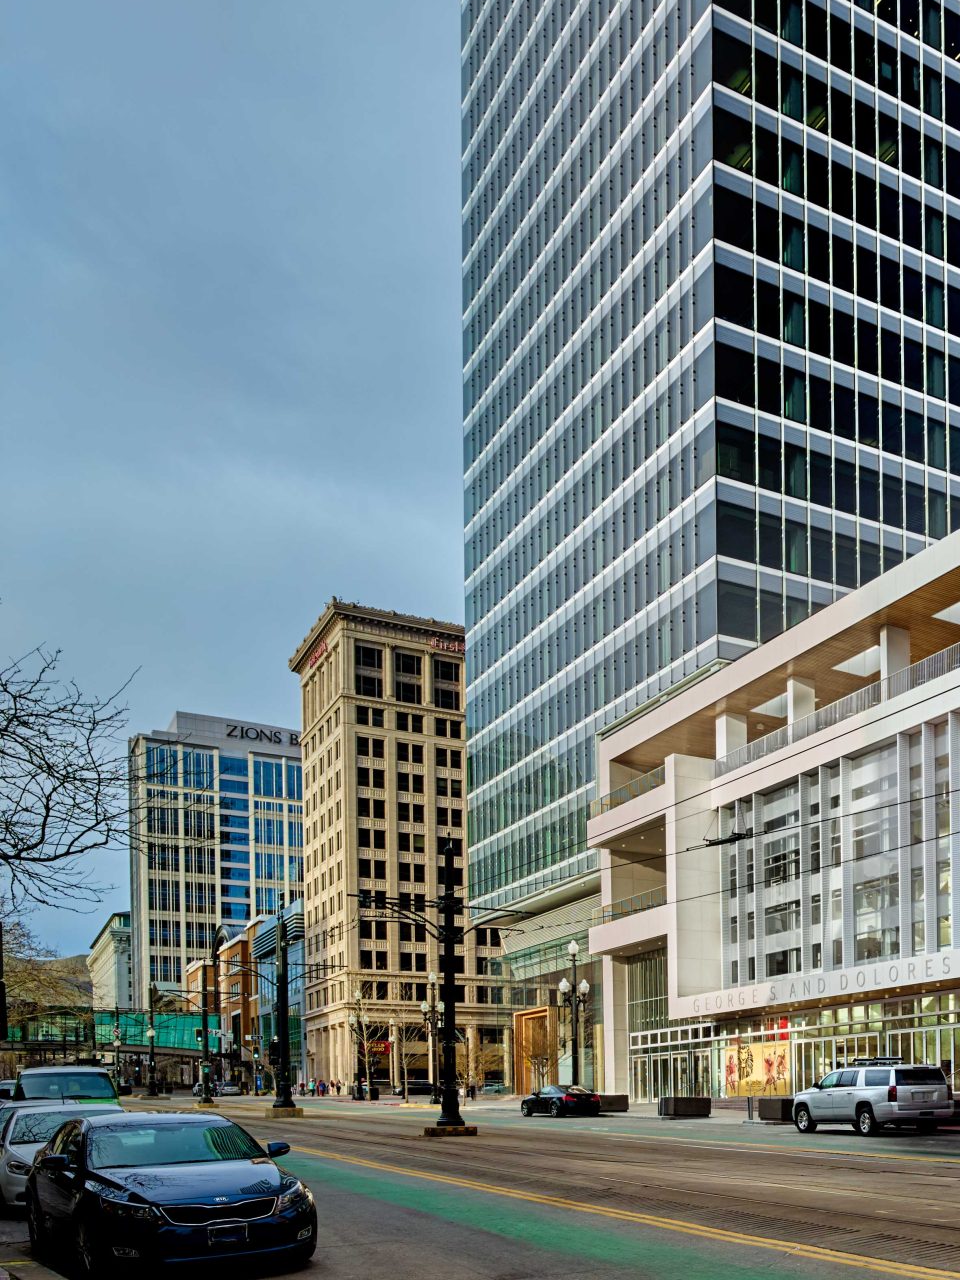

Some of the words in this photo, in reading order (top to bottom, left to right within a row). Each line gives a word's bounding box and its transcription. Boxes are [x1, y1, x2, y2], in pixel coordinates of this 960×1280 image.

[226, 724, 282, 744] ZIONS
[692, 985, 759, 1013] GEORGE
[789, 978, 827, 1000] AND
[839, 956, 952, 991] DOLORES
